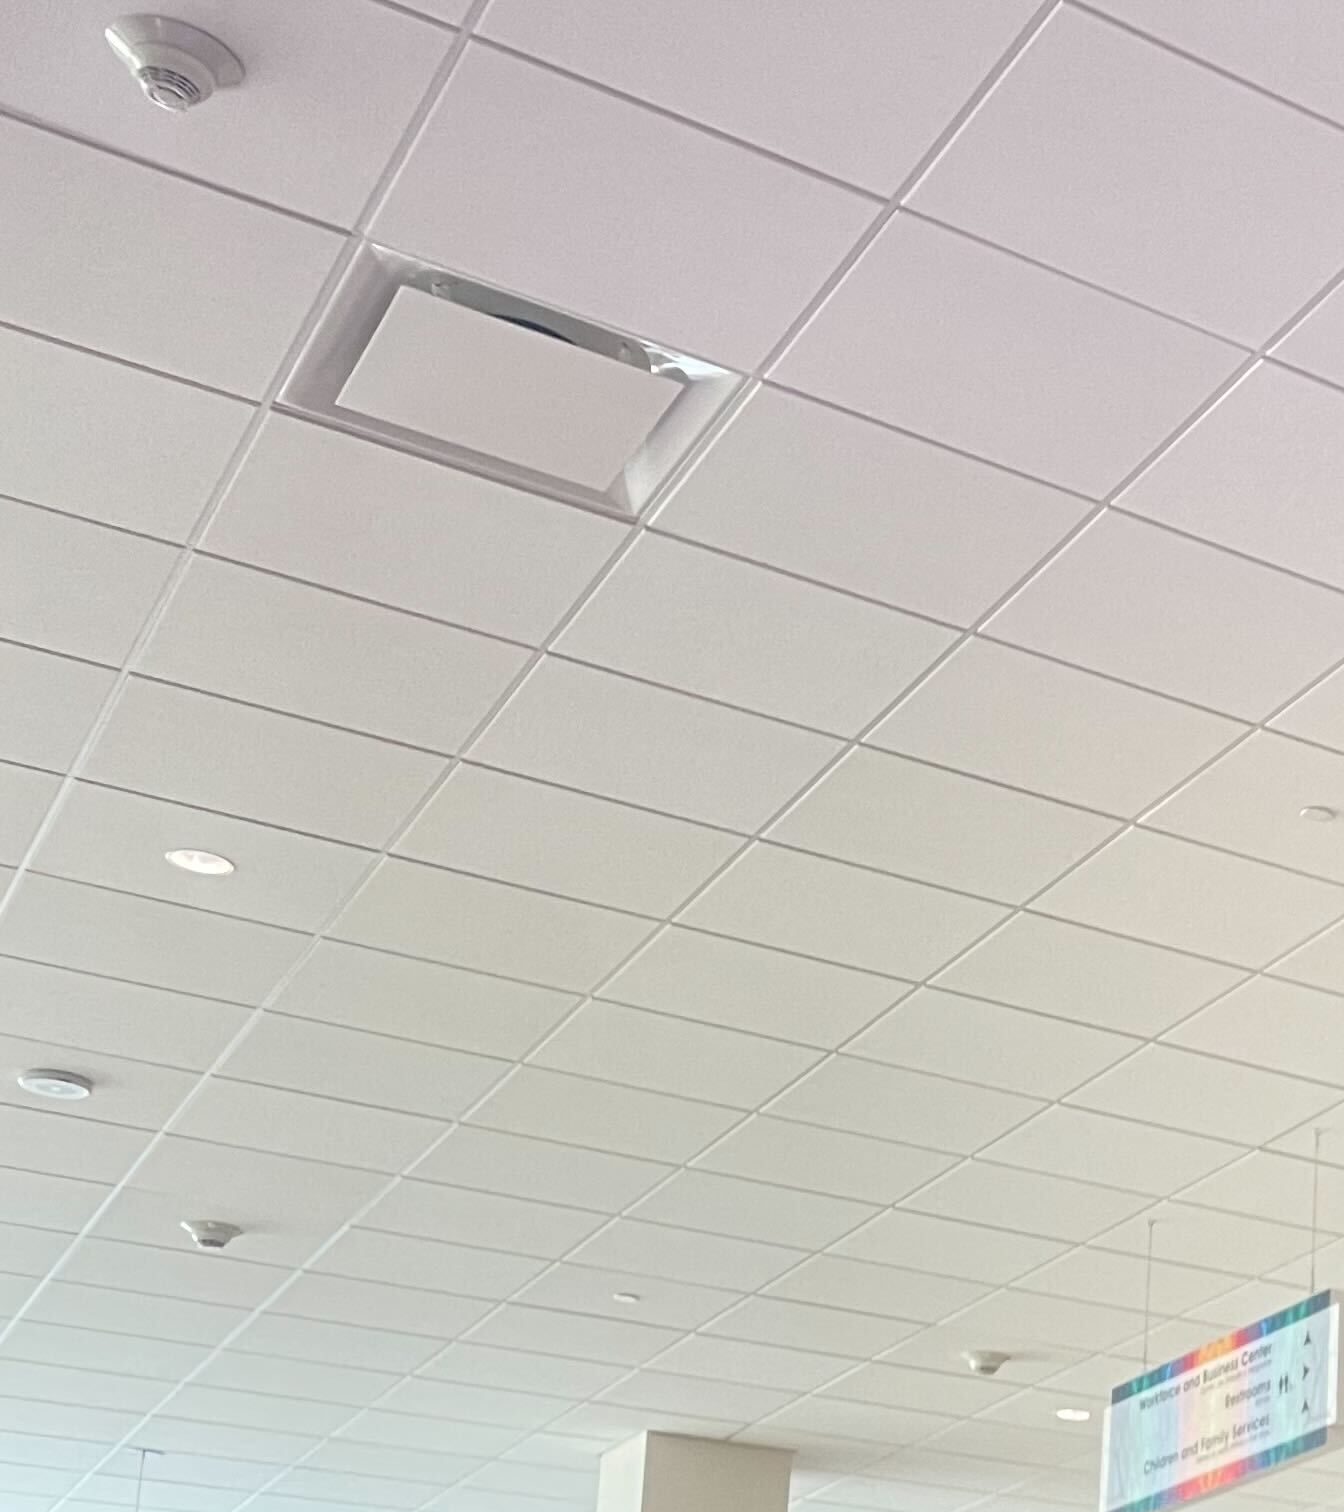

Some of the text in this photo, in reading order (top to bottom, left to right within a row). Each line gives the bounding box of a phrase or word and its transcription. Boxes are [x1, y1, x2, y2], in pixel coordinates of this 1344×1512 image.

[1183, 1375, 1200, 1391] and
[1203, 1359, 1239, 1384] Business
[1241, 1343, 1273, 1366] Center
[1225, 1380, 1271, 1408] Restrooms
[1144, 1449, 1178, 1474] Children
[1181, 1440, 1199, 1459] and
[1201, 1429, 1229, 1450] Family
[1232, 1414, 1270, 1438] Services
